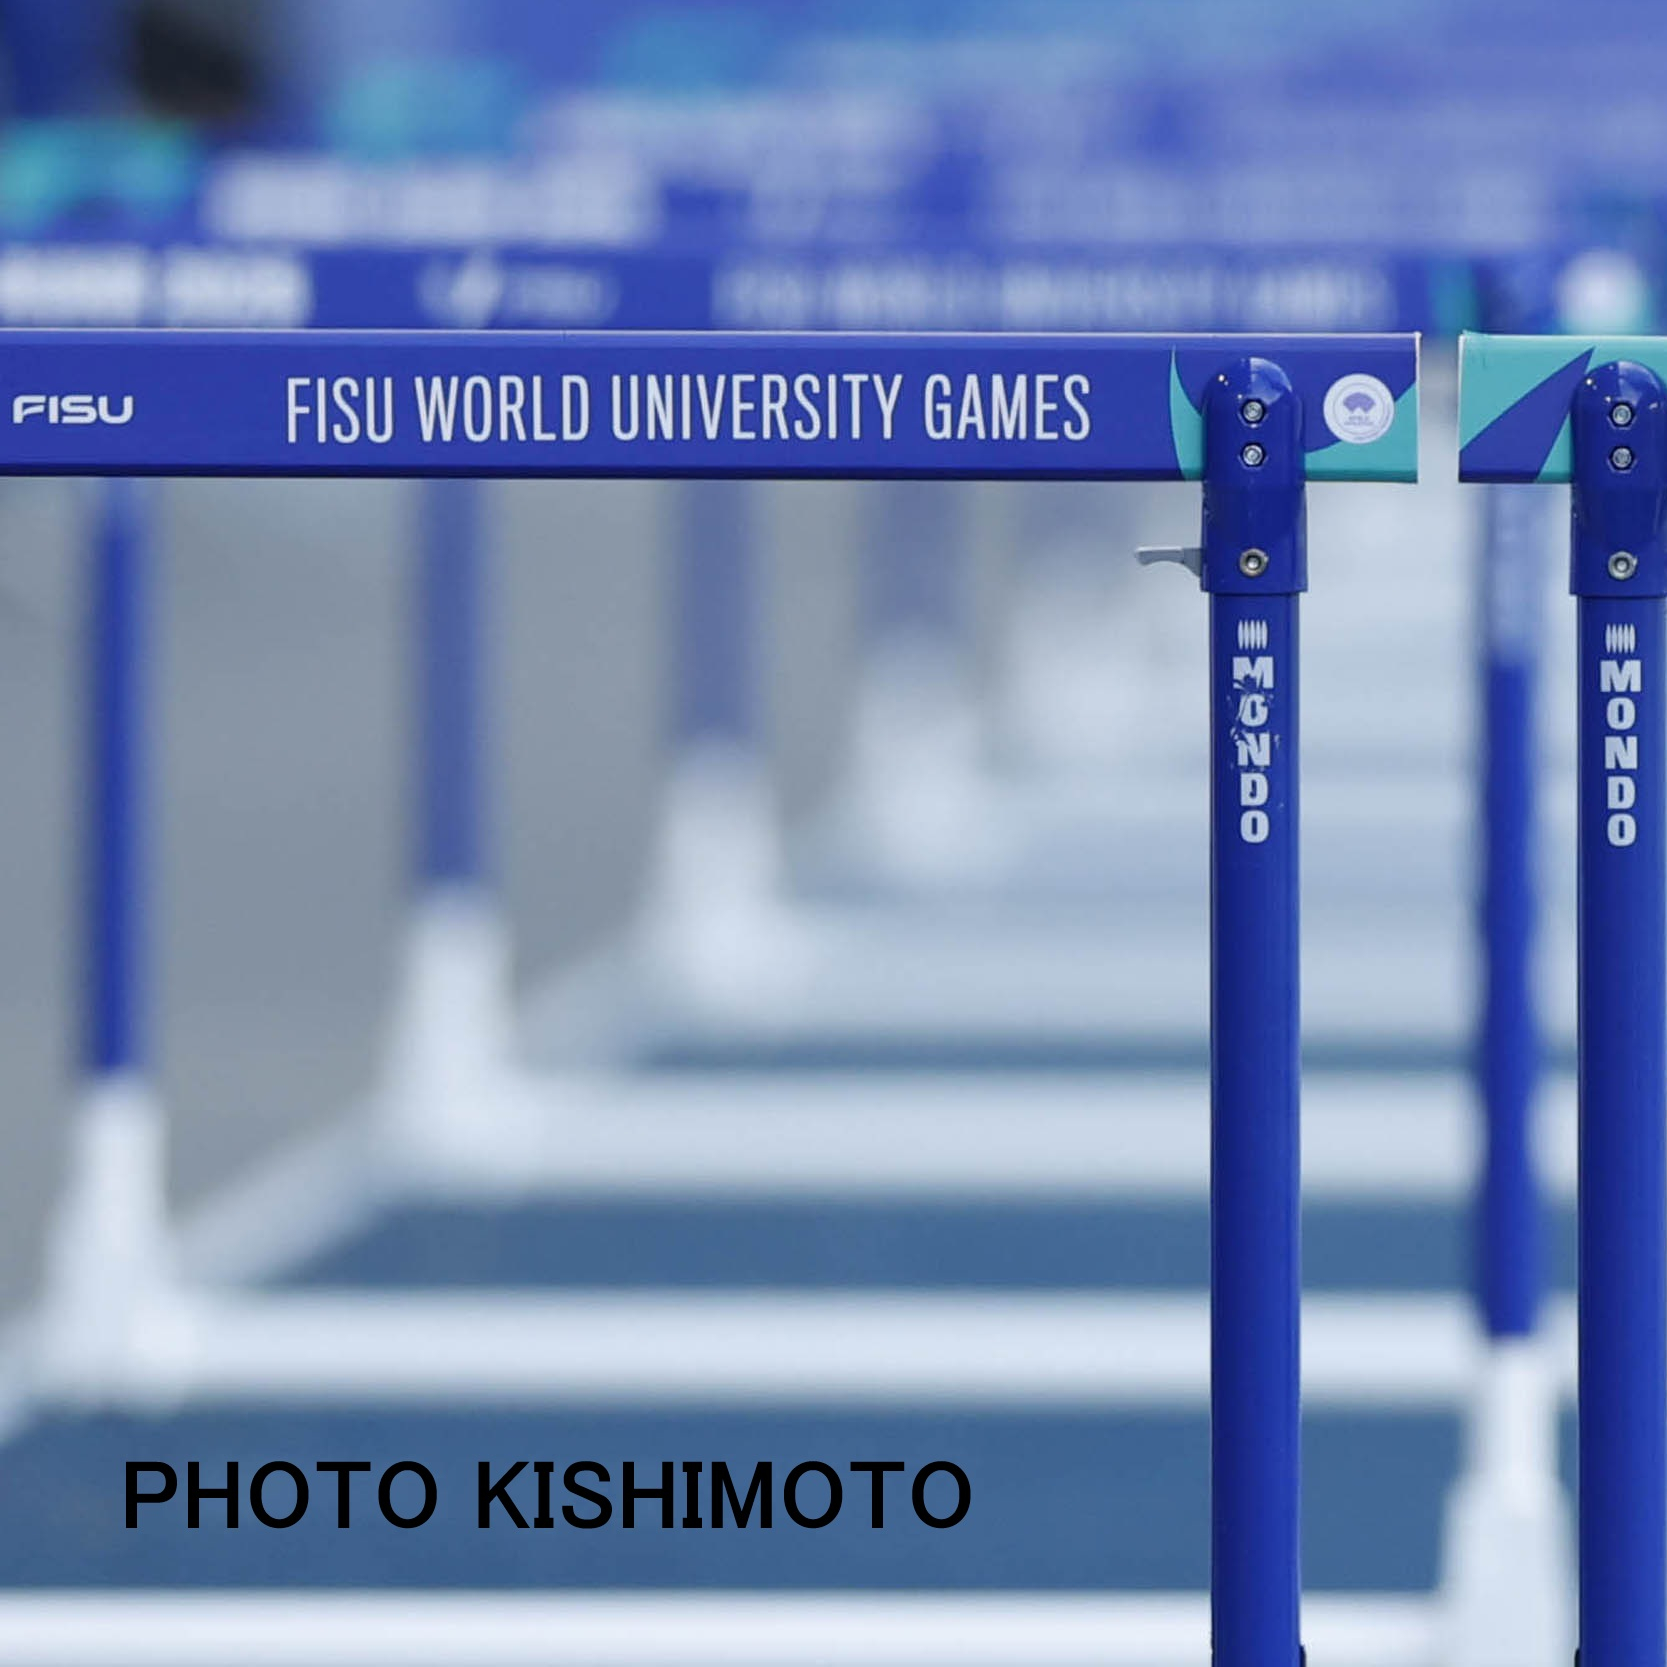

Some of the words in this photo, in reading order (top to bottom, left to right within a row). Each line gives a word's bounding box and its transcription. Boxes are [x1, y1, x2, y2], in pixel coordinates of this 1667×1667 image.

[12, 395, 134, 424] FISU
[286, 377, 394, 444] FISU
[414, 375, 590, 442] WORLD
[611, 373, 904, 441] UNIVERSITY
[923, 373, 1091, 440] GAMES
[1232, 656, 1274, 843] MONDO
[1600, 659, 1641, 847] MONDO
